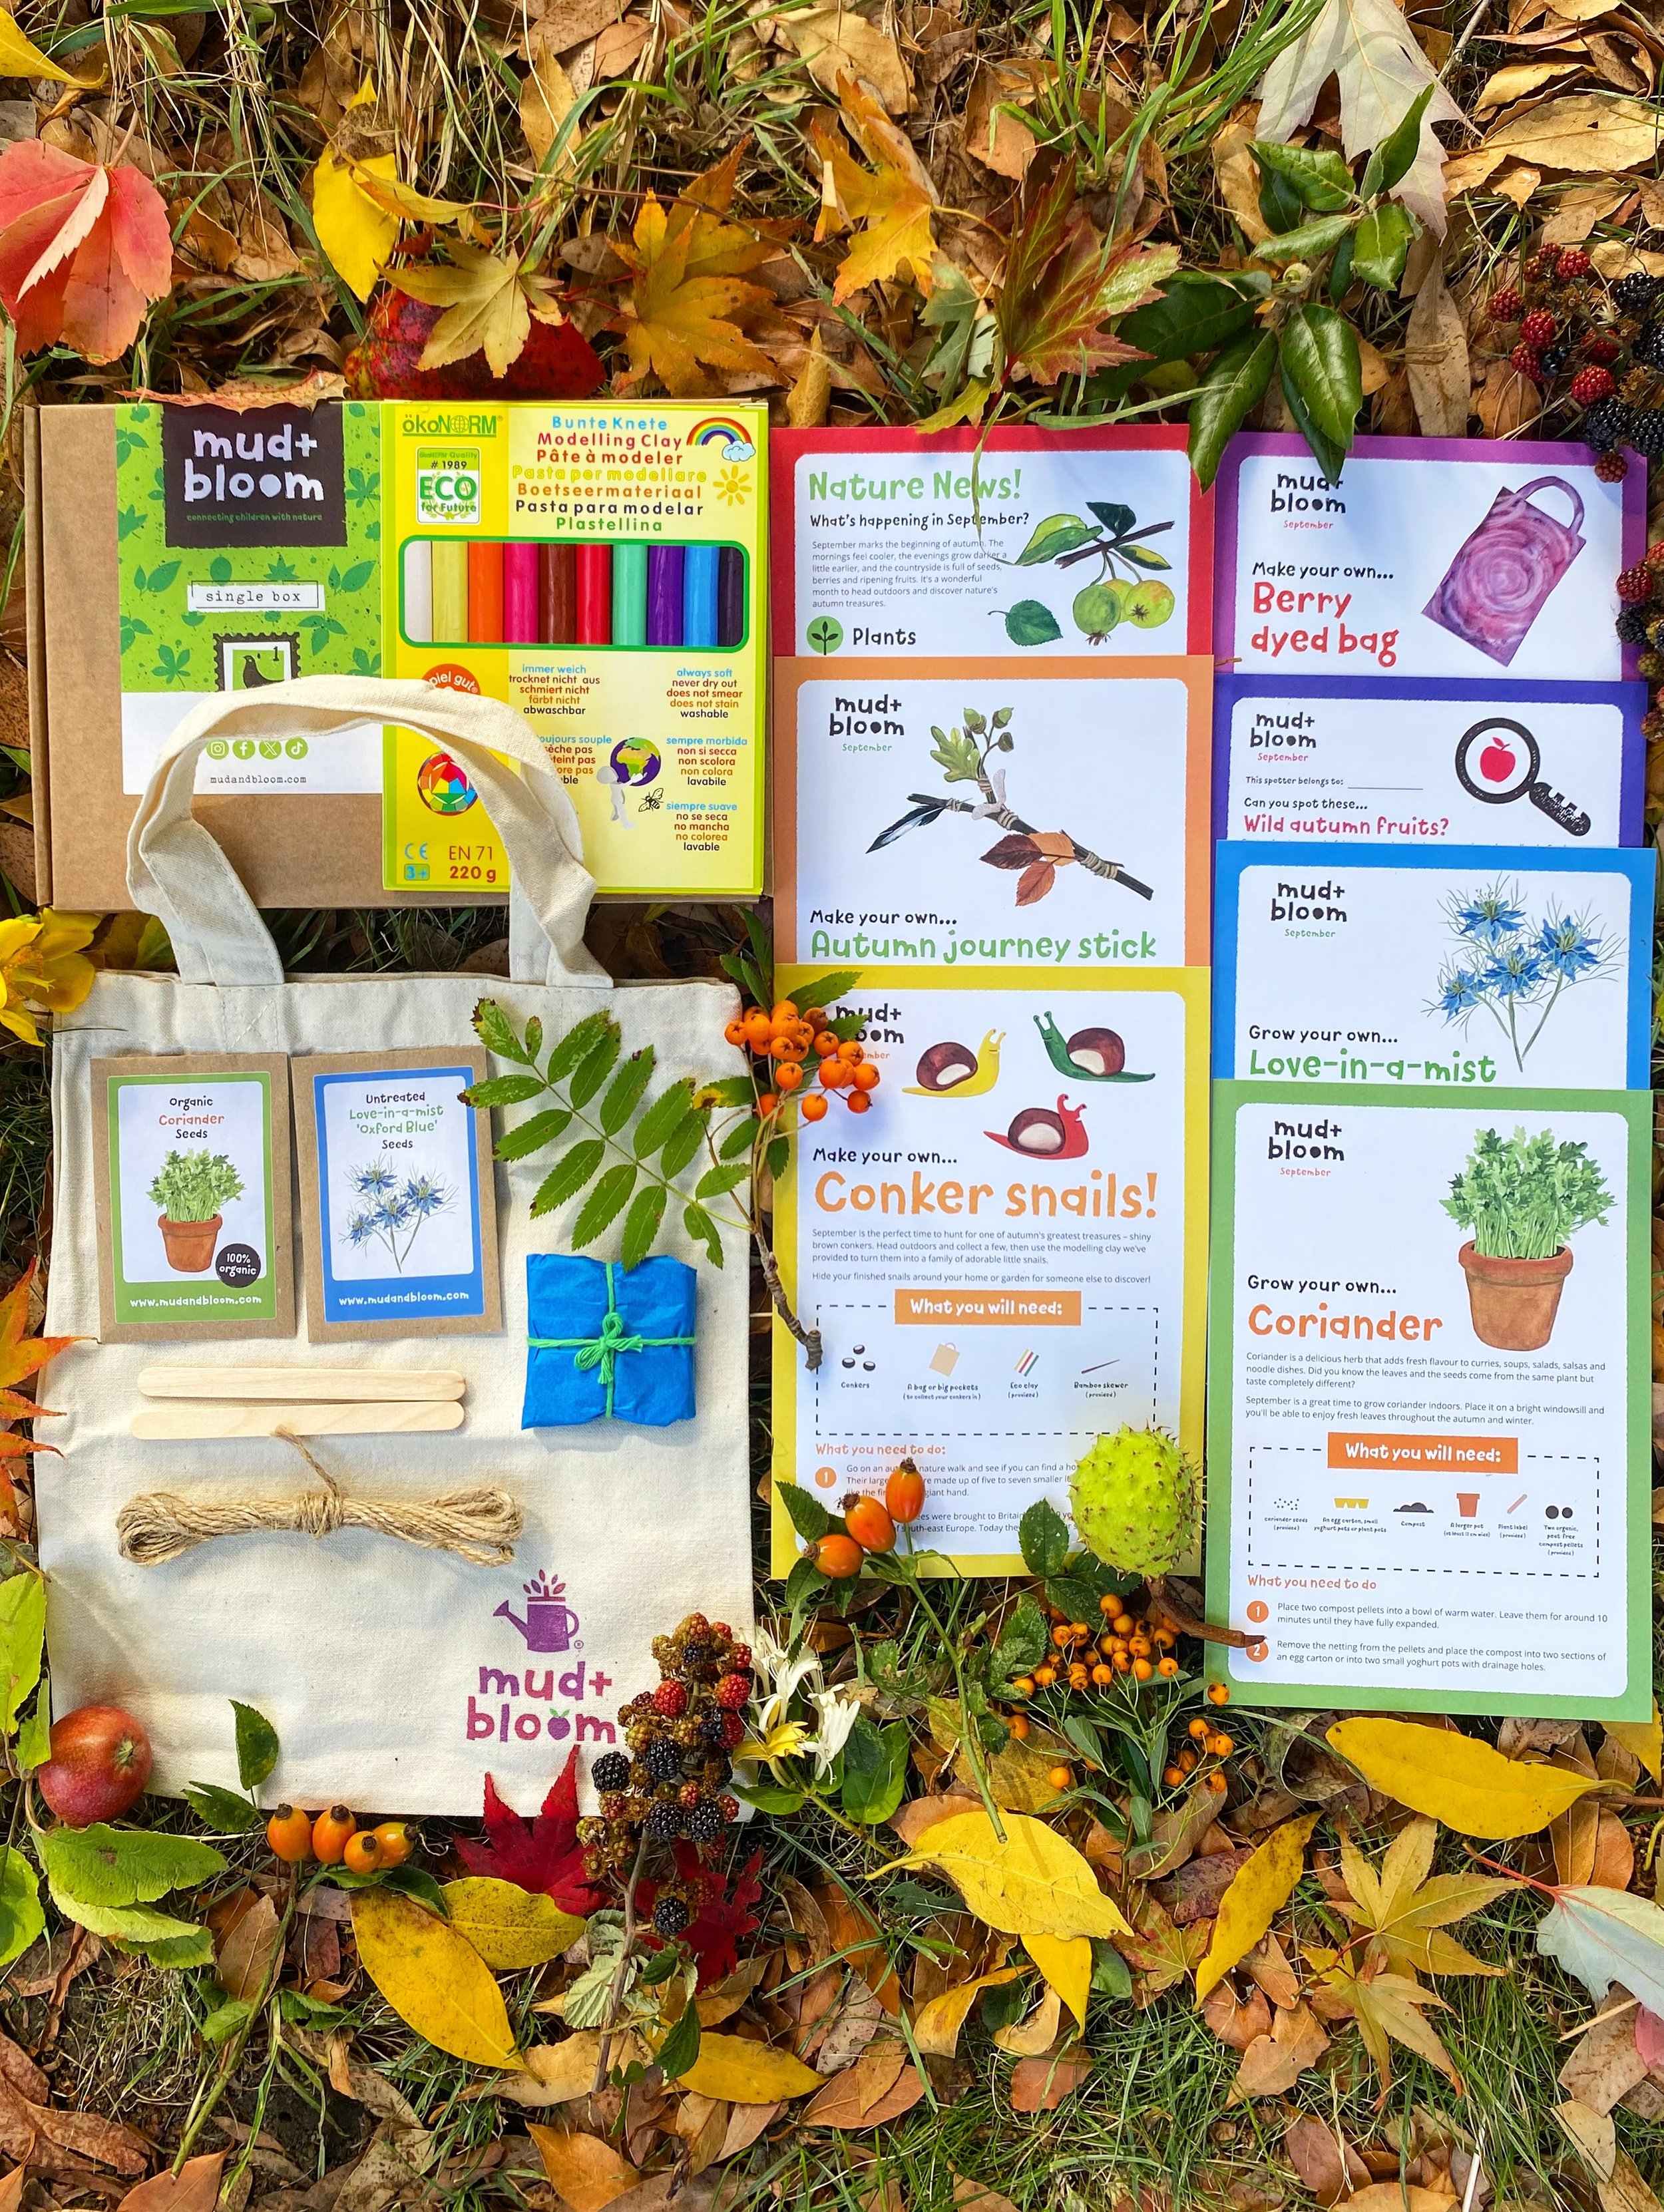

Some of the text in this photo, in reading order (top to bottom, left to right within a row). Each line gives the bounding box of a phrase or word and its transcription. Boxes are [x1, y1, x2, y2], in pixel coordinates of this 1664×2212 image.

[552, 416, 667, 431] Bunte Knete
[194, 424, 317, 462] mud+
[538, 433, 682, 451] Modelling Clay
[537, 449, 683, 465] Pâte à modeler
[184, 459, 323, 502] bloom
[513, 465, 707, 484] Pasta per modellare
[420, 476, 477, 500] ECO
[519, 482, 700, 499] Boetseermateriaal
[809, 468, 1022, 501] Nature News!
[517, 500, 703, 517] Pasta para modelar
[1271, 489, 1345, 514] bloom
[187, 512, 322, 524] connecting children with nature
[557, 517, 662, 532] Plastellina
[811, 514, 855, 527] What's
[860, 513, 929, 531] happening
[933, 513, 943, 526] in
[1284, 520, 1333, 530] September
[813, 541, 856, 551] September
[901, 540, 940, 550] beginning
[1253, 562, 1393, 580] Make your own...
[206, 590, 300, 605] single box
[1254, 582, 1352, 620] Berry
[854, 628, 916, 645] Plants
[1251, 623, 1399, 668] dyed bag
[522, 664, 586, 675] immer weich
[677, 668, 732, 680] always soft
[509, 674, 550, 685] trocknet
[553, 675, 577, 684] nicht
[703, 678, 718, 690] dry
[722, 679, 737, 688] out
[520, 685, 590, 695] schmiert nicht
[667, 688, 690, 697] does
[712, 688, 743, 698] smear
[529, 695, 580, 707] färbt nicht
[670, 699, 739, 709] does not stain
[833, 694, 901, 715] mud+
[524, 705, 586, 715] abwaschbar
[680, 709, 728, 719] washable
[829, 714, 904, 737] bloom
[1257, 712, 1315, 729] mud+
[667, 737, 748, 749] sempre morbida
[1250, 728, 1316, 749] bloom
[843, 743, 892, 754] September
[1258, 753, 1308, 763] September
[210, 775, 306, 784] mudandbloom.com
[1246, 776, 1262, 785] This
[1264, 777, 1296, 786] spotter
[1299, 777, 1329, 788] belongs
[1245, 798, 1367, 811] Can you spot these...
[1245, 815, 1448, 836] Wild autumn fruits?
[449, 846, 492, 861] EN 71
[450, 866, 496, 884] 220 g
[1278, 880, 1345, 900] mud+
[1271, 898, 1347, 922] bloom
[810, 910, 956, 927] Make your own...
[1285, 929, 1335, 939] September
[812, 930, 1156, 963] Autumn journey stick
[1249, 1025, 1397, 1043] Grow your own...
[1251, 1048, 1496, 1083] Love-in-a-mist
[170, 1095, 212, 1111] Organic
[367, 1092, 425, 1104] Untreated
[159, 1113, 224, 1126] Coriander
[350, 1104, 443, 1120] Love-in-a-mist
[176, 1129, 207, 1139] Seeds
[357, 1119, 437, 1135] 'Oxford Blue'
[1275, 1119, 1342, 1139] mud+
[382, 1139, 413, 1149] Seeds
[1269, 1137, 1344, 1161] bloom
[813, 1147, 956, 1165] Make your own...
[1281, 1167, 1331, 1178] September
[815, 1170, 1157, 1219] Conker snails!
[228, 1252, 250, 1264] 100%
[218, 1262, 258, 1278] organic
[1248, 1275, 1396, 1294] Grow your own...
[130, 1295, 262, 1308] www.mudandbloom.com
[339, 1292, 469, 1306] www.mudandbloom.com
[911, 1298, 1062, 1317] What you will need:
[1249, 1303, 1443, 1342] Coriander
[1346, 1443, 1500, 1463] What you will need:
[1278, 1616, 1311, 1624] minutes
[1334, 1617, 1352, 1628] they
[1354, 1618, 1374, 1626] have
[1376, 1618, 1394, 1629] fully
[1396, 1620, 1439, 1630] expanded.
[479, 1661, 612, 1701] mud+
[467, 1696, 617, 1745] bloom
